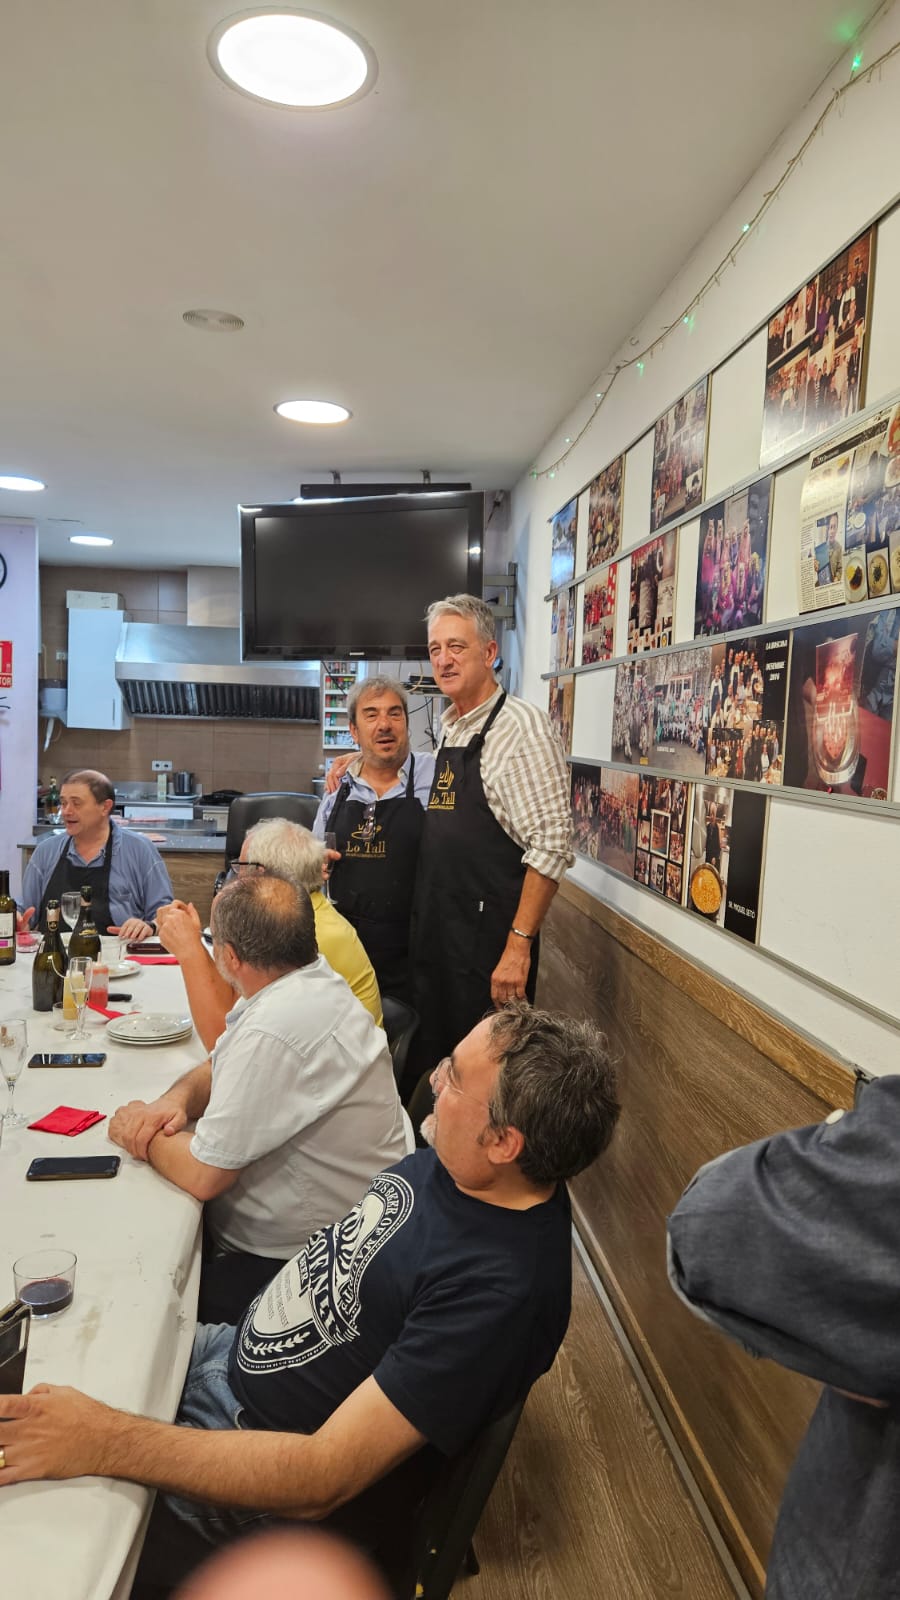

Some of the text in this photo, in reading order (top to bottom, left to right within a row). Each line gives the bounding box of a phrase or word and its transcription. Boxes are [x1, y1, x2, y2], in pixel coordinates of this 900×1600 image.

[430, 791, 456, 804] Lo Tall
[346, 840, 385, 853] Lo Tall
